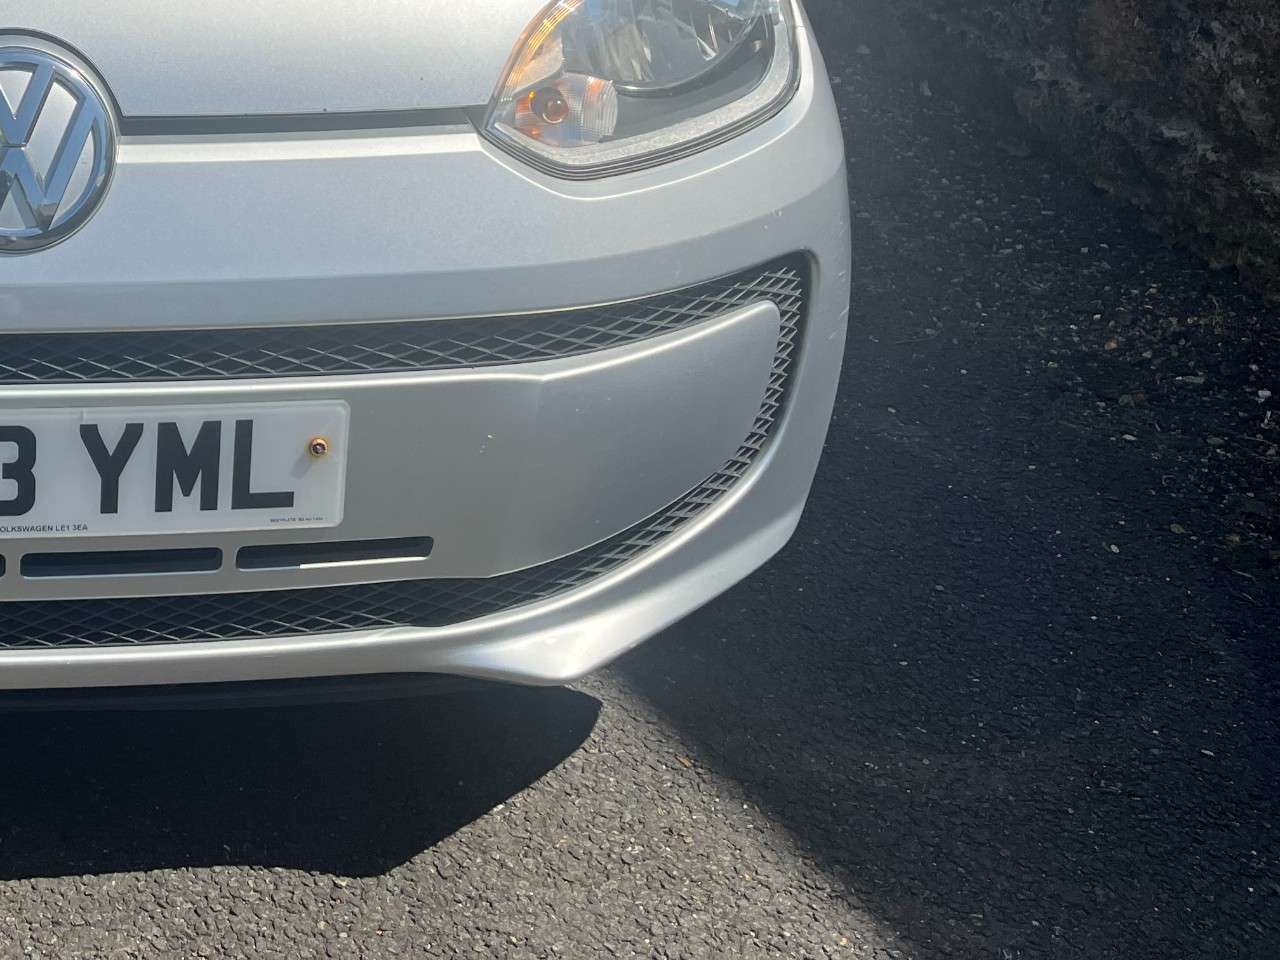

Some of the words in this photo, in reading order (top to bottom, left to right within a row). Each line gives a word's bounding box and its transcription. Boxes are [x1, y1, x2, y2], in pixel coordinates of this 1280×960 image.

[79, 419, 295, 514] YML
[55, 524, 70, 532] LE1
[72, 523, 89, 531] 3EA
